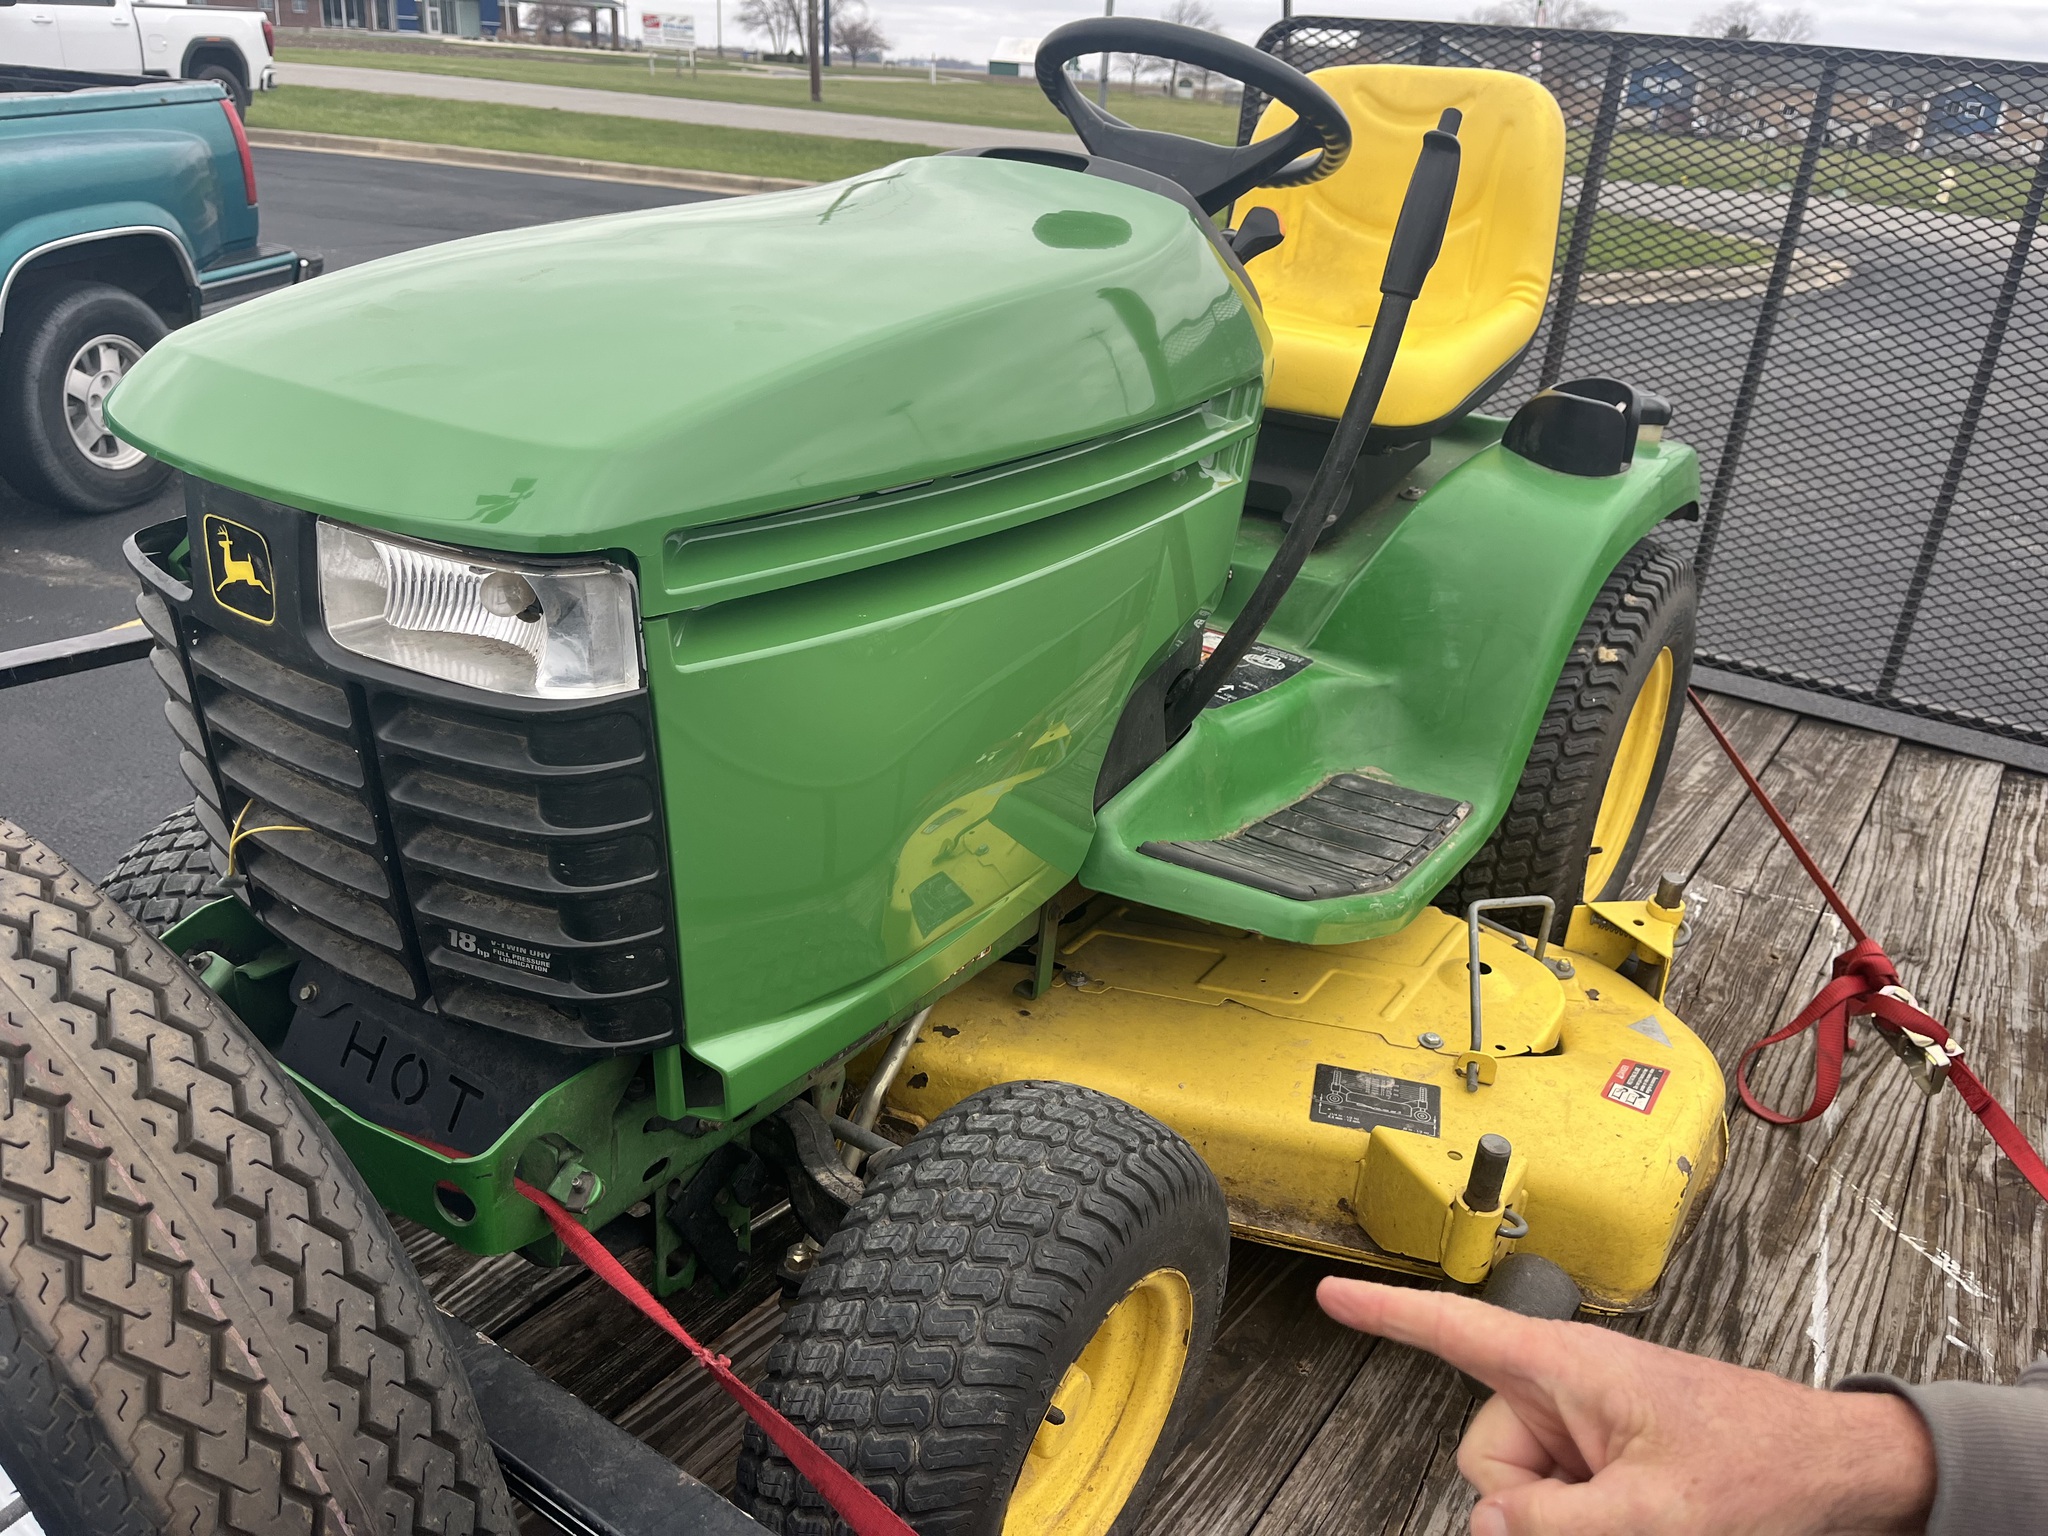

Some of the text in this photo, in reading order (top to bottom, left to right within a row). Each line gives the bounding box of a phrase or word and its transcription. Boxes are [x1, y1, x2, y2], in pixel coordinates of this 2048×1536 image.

[448, 928, 490, 958] 18 hp
[492, 948, 551, 968] FULL PRESSURE
[499, 956, 548, 973] LUBRICATION
[529, 950, 552, 960] UHV
[340, 1020, 485, 1133] HOT
